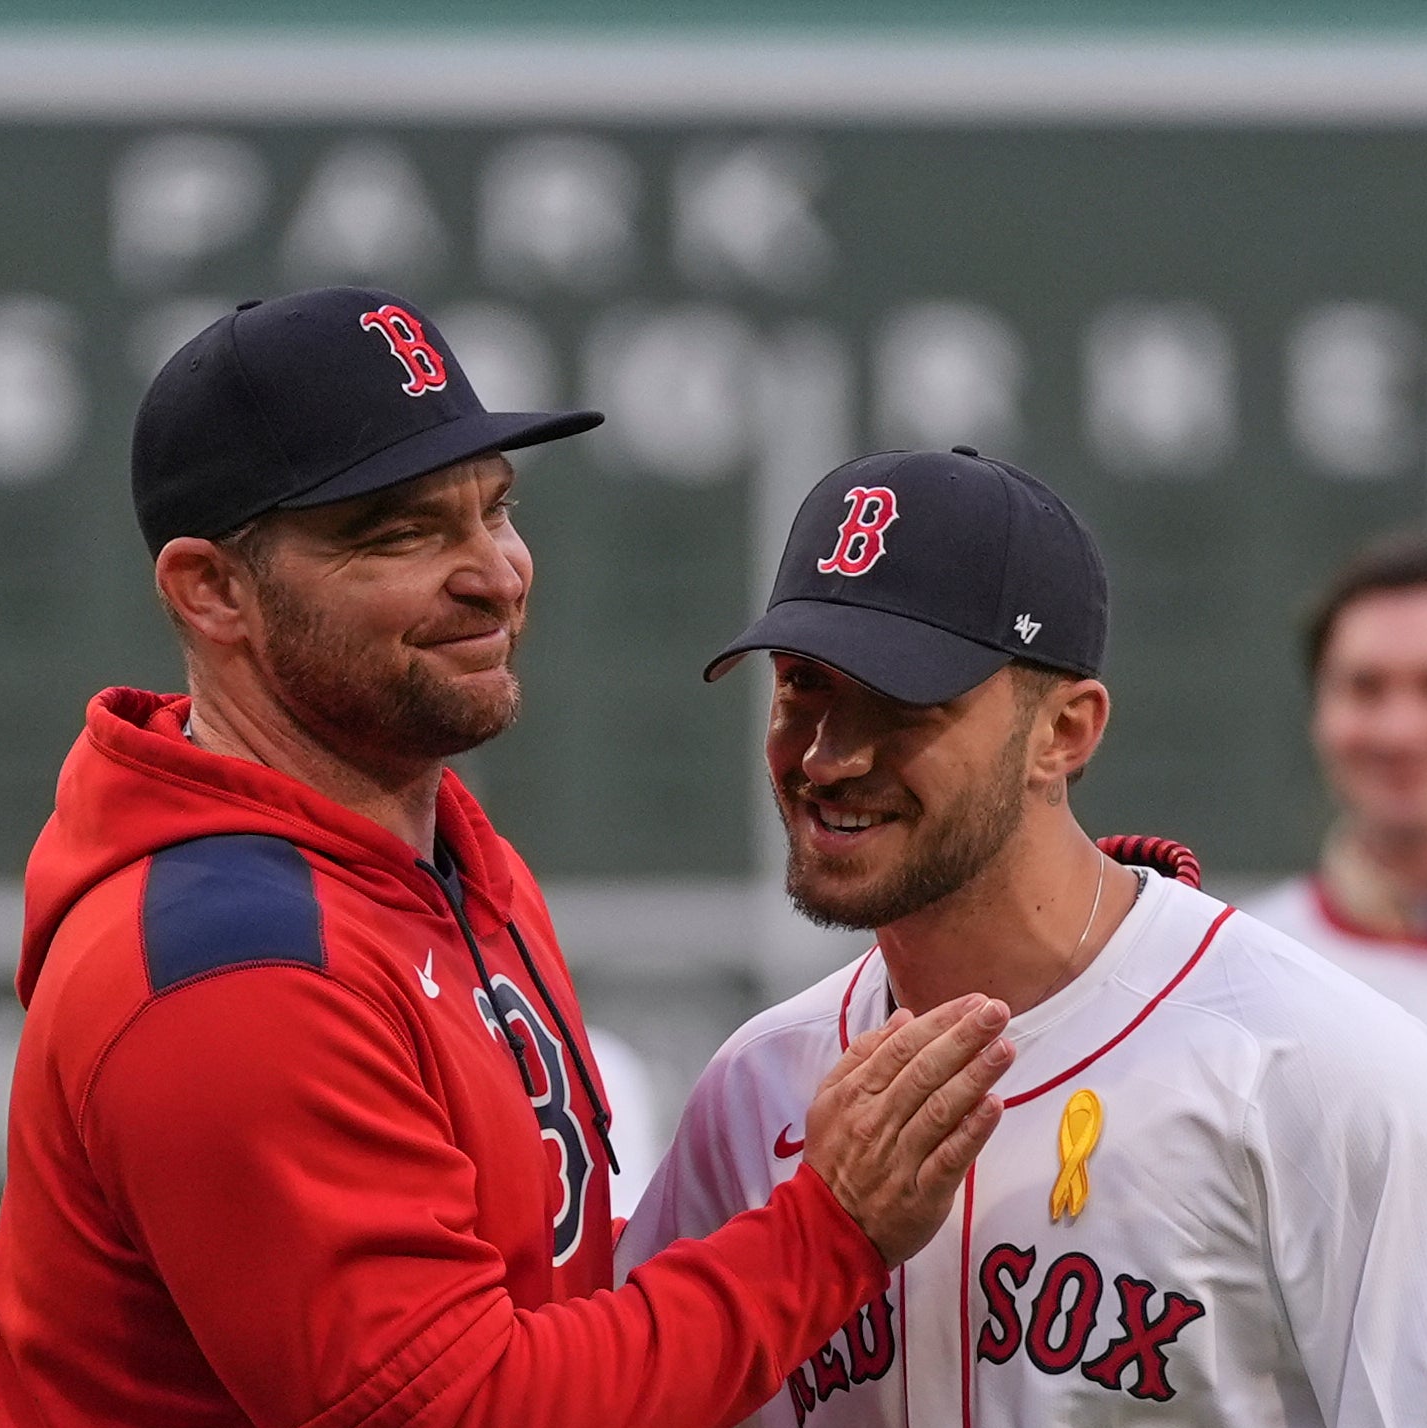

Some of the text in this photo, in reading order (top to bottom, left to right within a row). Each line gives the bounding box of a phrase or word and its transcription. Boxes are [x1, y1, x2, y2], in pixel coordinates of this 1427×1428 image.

[110, 132, 837, 290] PARK
[359, 305, 448, 397] B
[817, 486, 900, 577] B
[977, 1242, 1206, 1402] SOX
